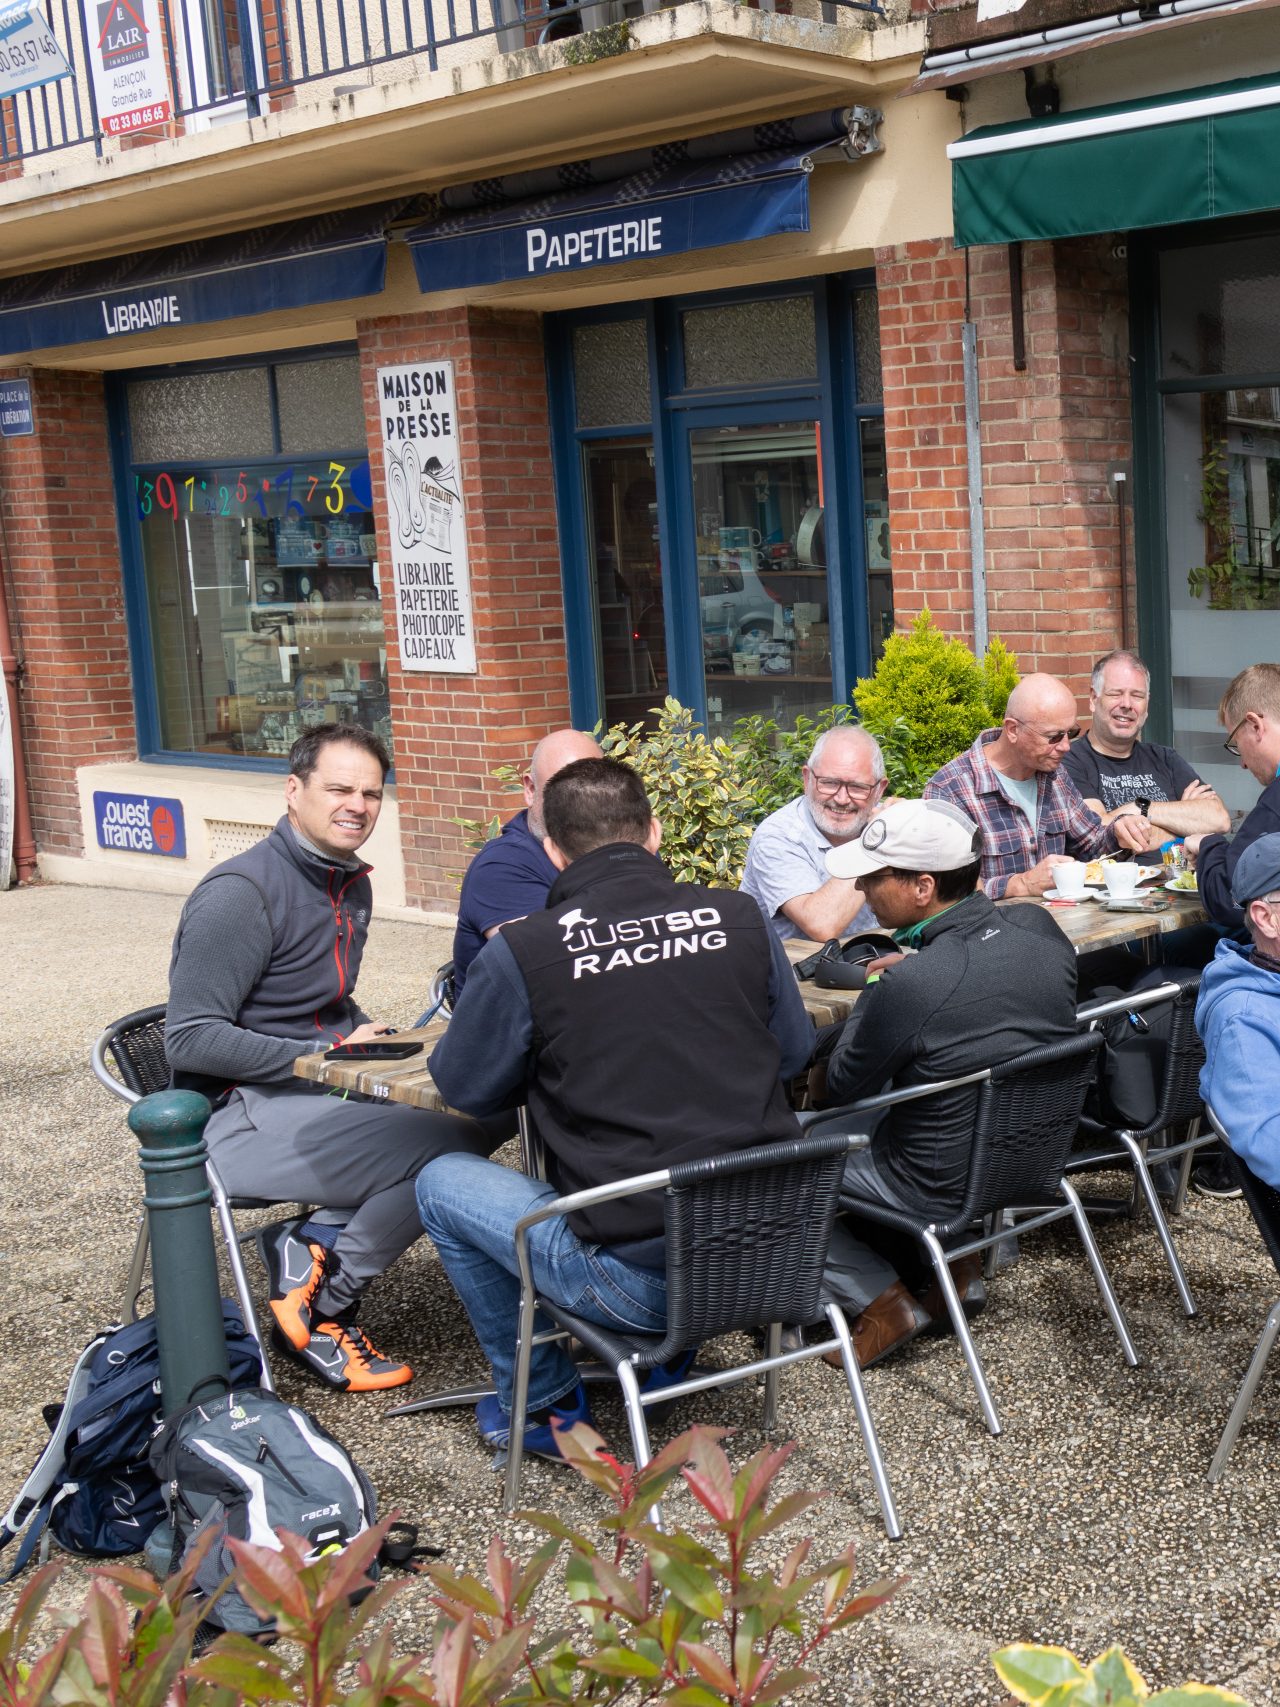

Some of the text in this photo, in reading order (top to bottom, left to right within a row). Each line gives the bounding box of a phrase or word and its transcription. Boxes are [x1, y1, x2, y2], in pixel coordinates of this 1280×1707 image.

[106, 27, 142, 50] LAIR
[8, 45, 26, 67] 63
[23, 40, 40, 62] 67
[38, 35, 56, 56] 46
[109, 50, 145, 66] IMMOBILIER
[113, 69, 146, 89] ALENÇON
[111, 88, 152, 107] Grande Rue
[109, 106, 164, 131] 02 33 80 65 65
[526, 216, 662, 272] PAPETERIE
[101, 295, 181, 335] LIBRAIRIE
[382, 370, 447, 400] MAISON
[1, 408, 30, 425] LIBÉRATION
[398, 398, 432, 413] DE LA
[386, 412, 452, 440] PRESSE
[398, 562, 455, 586] LIBRAIRIE
[400, 589, 460, 611] PAPETERIE
[402, 614, 466, 636] PHOTOCOPIE
[404, 637, 457, 660] CADEAUX
[1101, 779, 1121, 789] WILL
[106, 799, 151, 827] ouest
[102, 817, 153, 850] france
[566, 907, 721, 953] JUSTSO
[573, 930, 727, 980] RACING
[373, 1084, 389, 1098] 115
[230, 1414, 263, 1431] deuter
